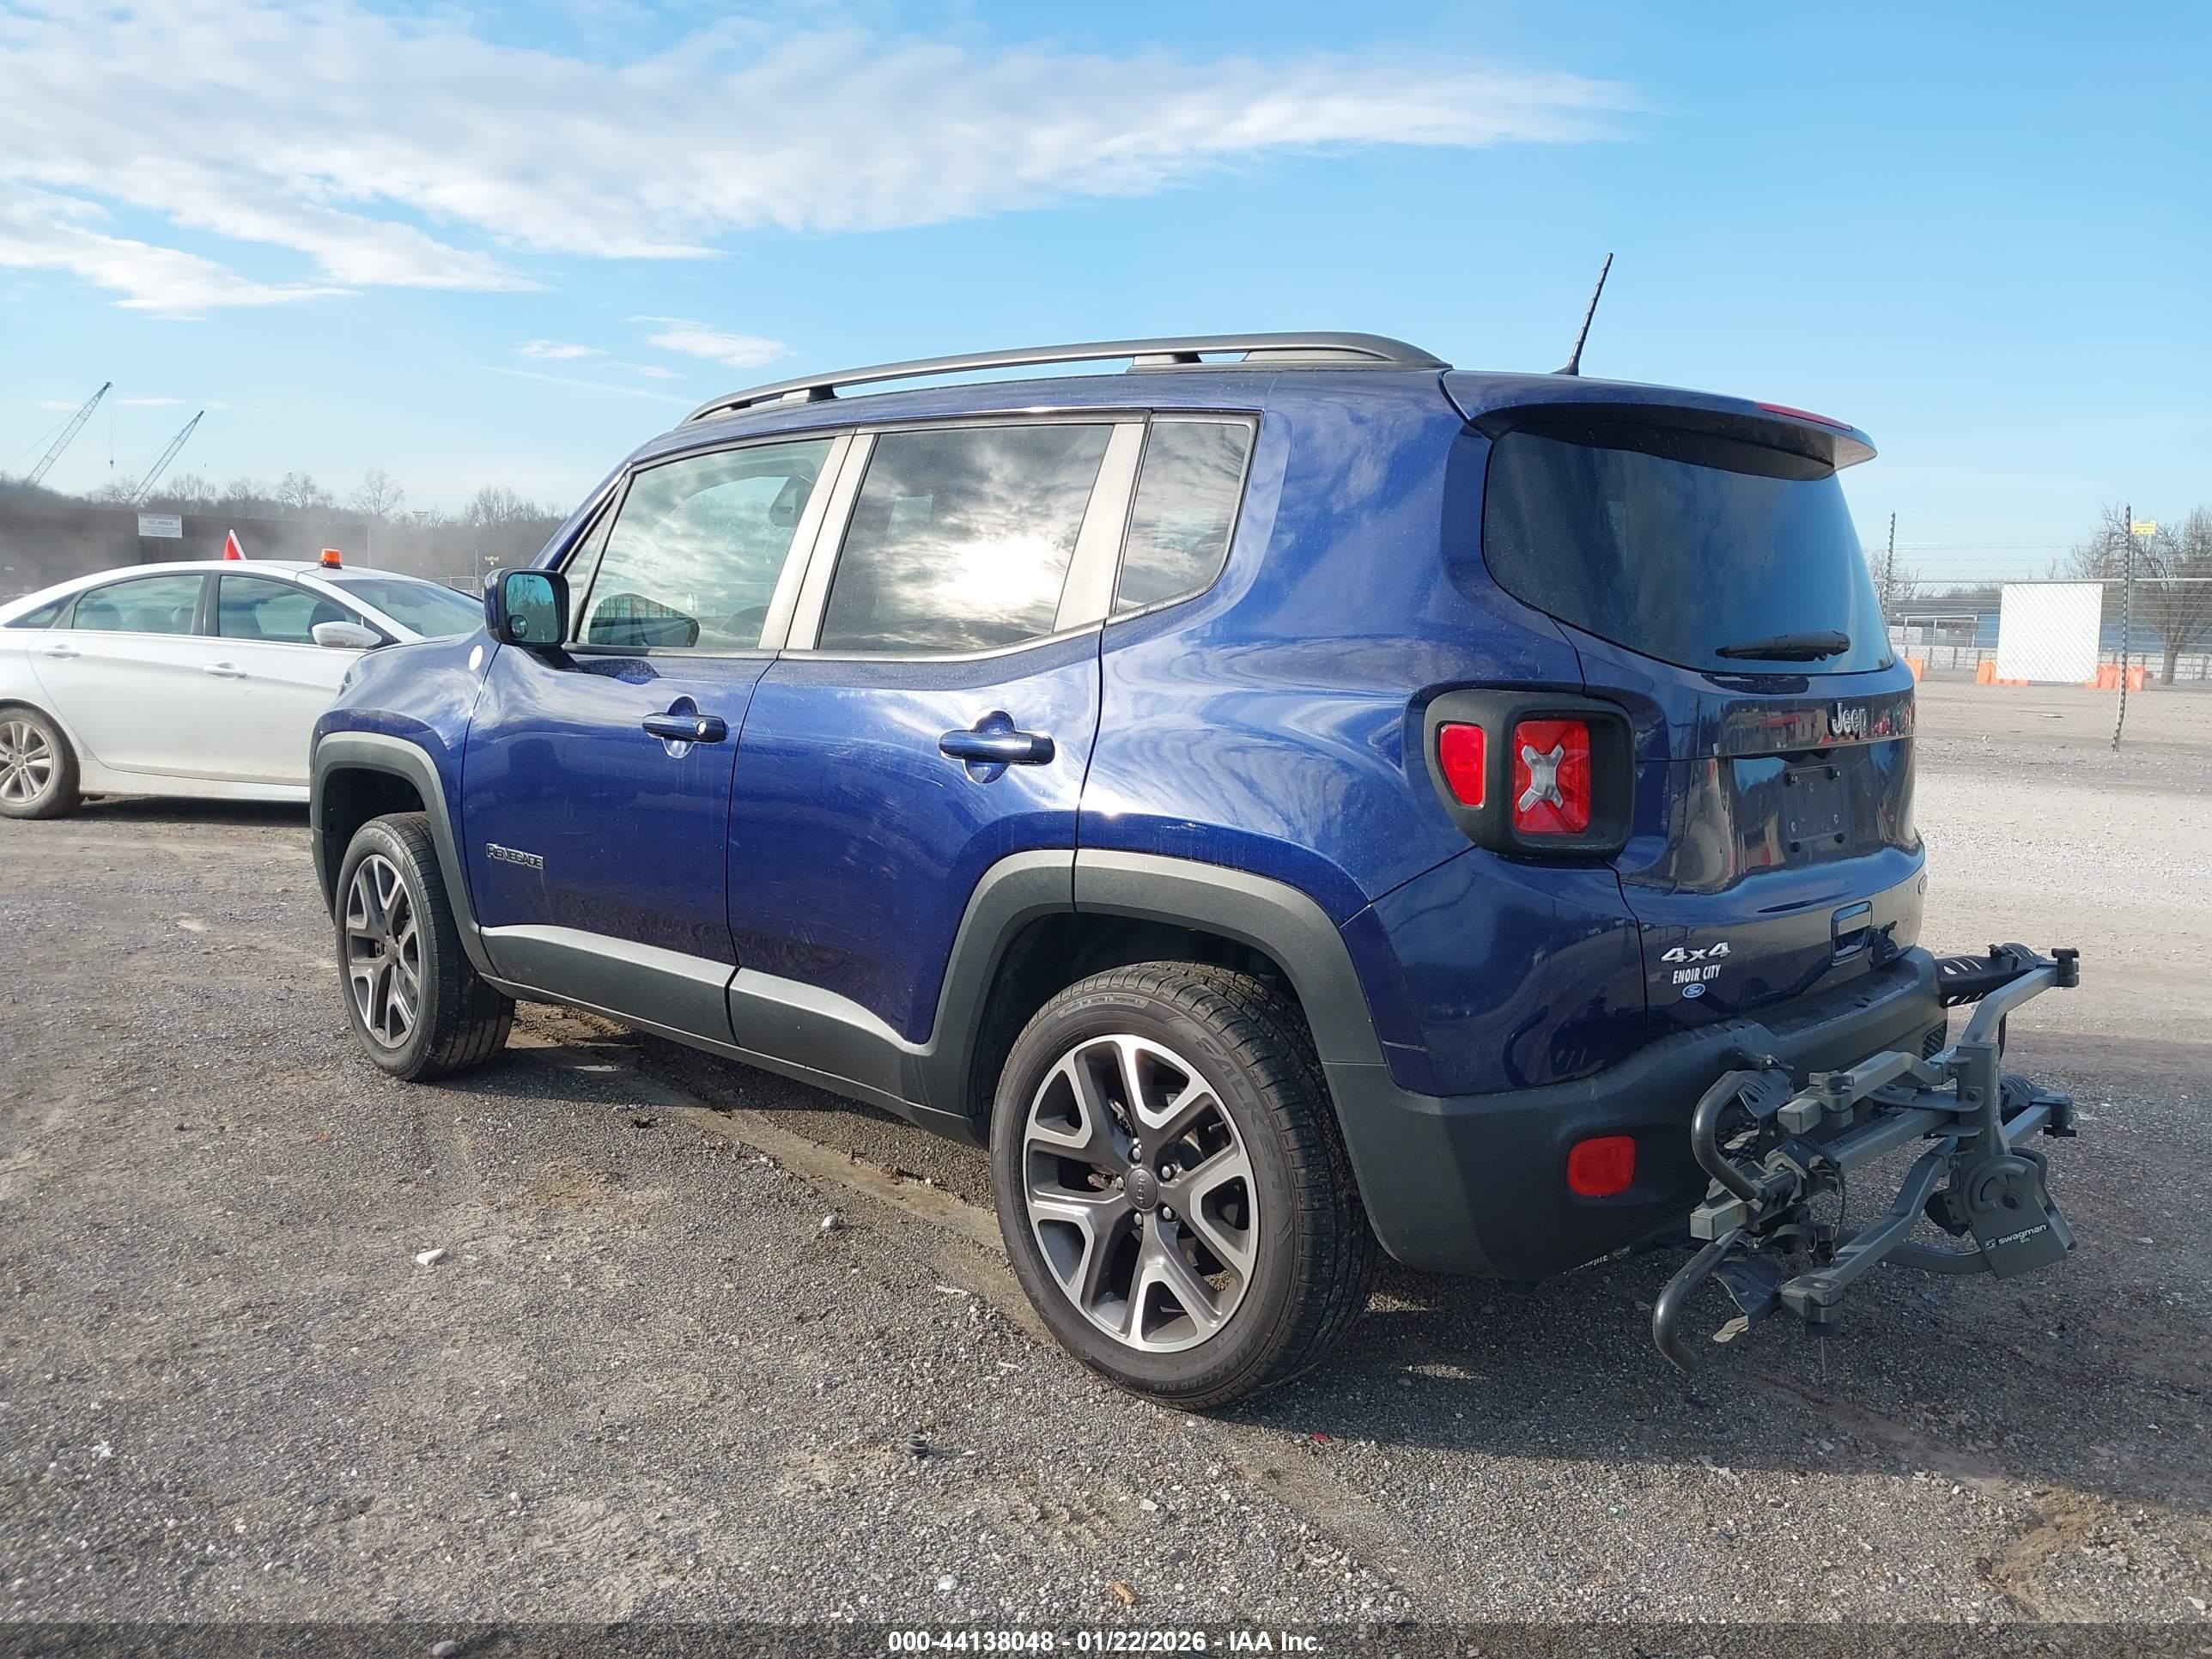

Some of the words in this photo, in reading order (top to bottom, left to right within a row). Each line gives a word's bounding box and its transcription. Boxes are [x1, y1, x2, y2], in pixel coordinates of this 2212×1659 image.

[1831, 702, 1868, 739] Jeep
[486, 842, 544, 870] RENEGADE
[1660, 942, 1731, 963] 4x4
[1672, 967, 1700, 985] ENOIR
[1702, 963, 1722, 980] CITY
[1194, 1035, 1285, 1192] FALKEN
[1998, 1224, 2047, 1245] swagman
